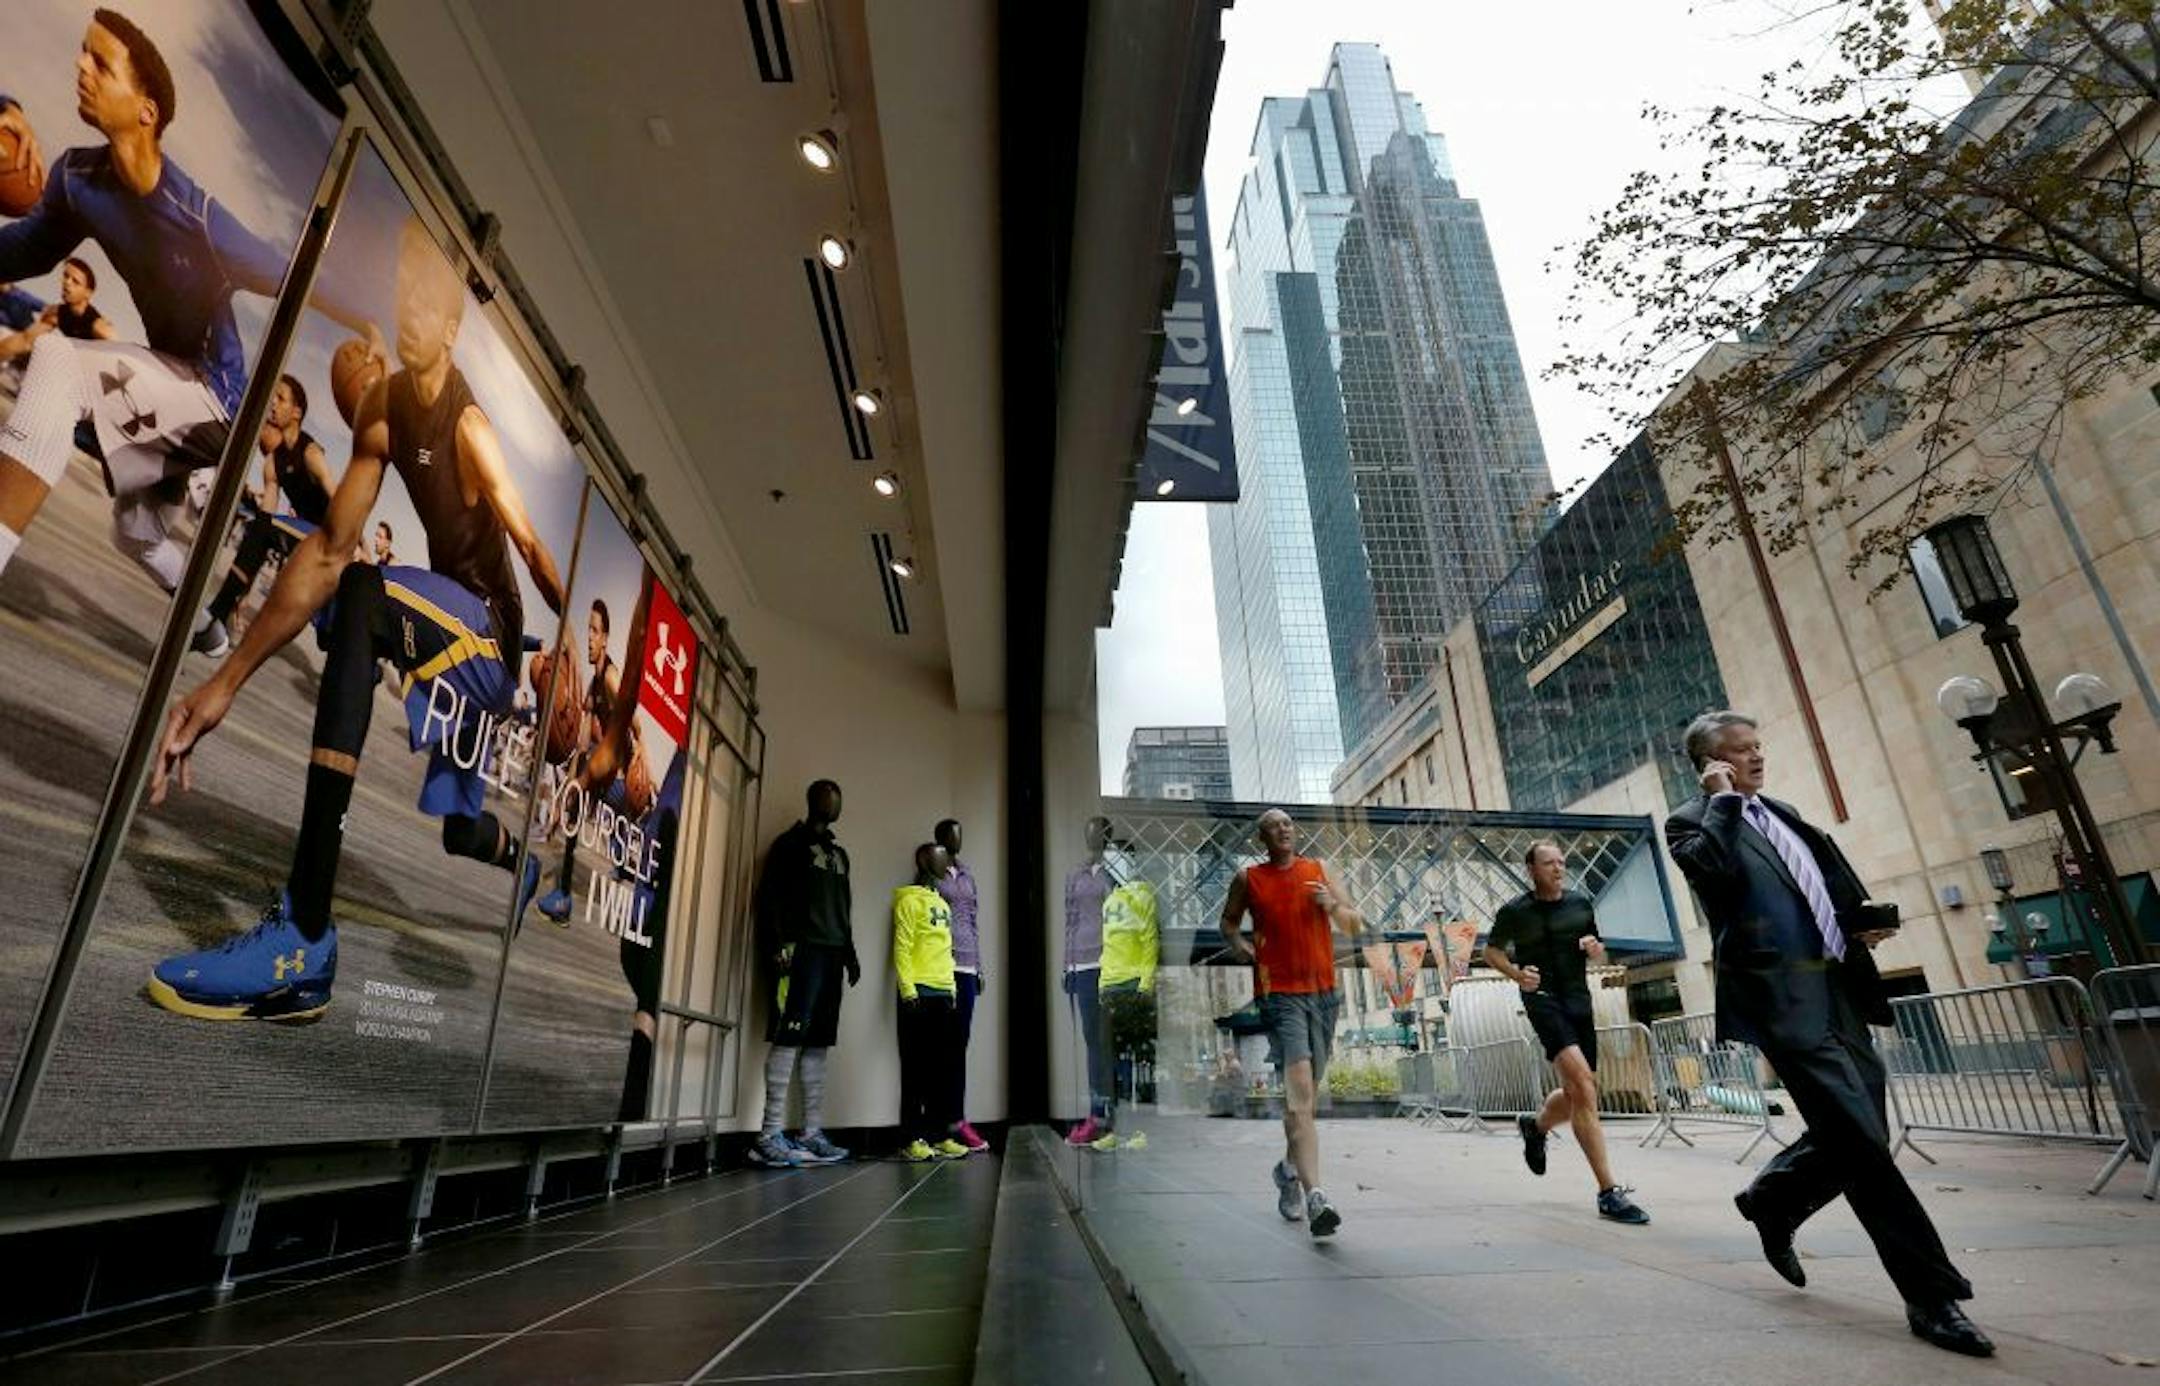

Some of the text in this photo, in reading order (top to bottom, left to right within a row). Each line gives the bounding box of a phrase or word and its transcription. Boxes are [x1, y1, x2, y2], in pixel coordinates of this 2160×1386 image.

[421, 676, 529, 798] RULE
[585, 869, 653, 949] I WILL.
[363, 979, 406, 1001] STEPHEN
